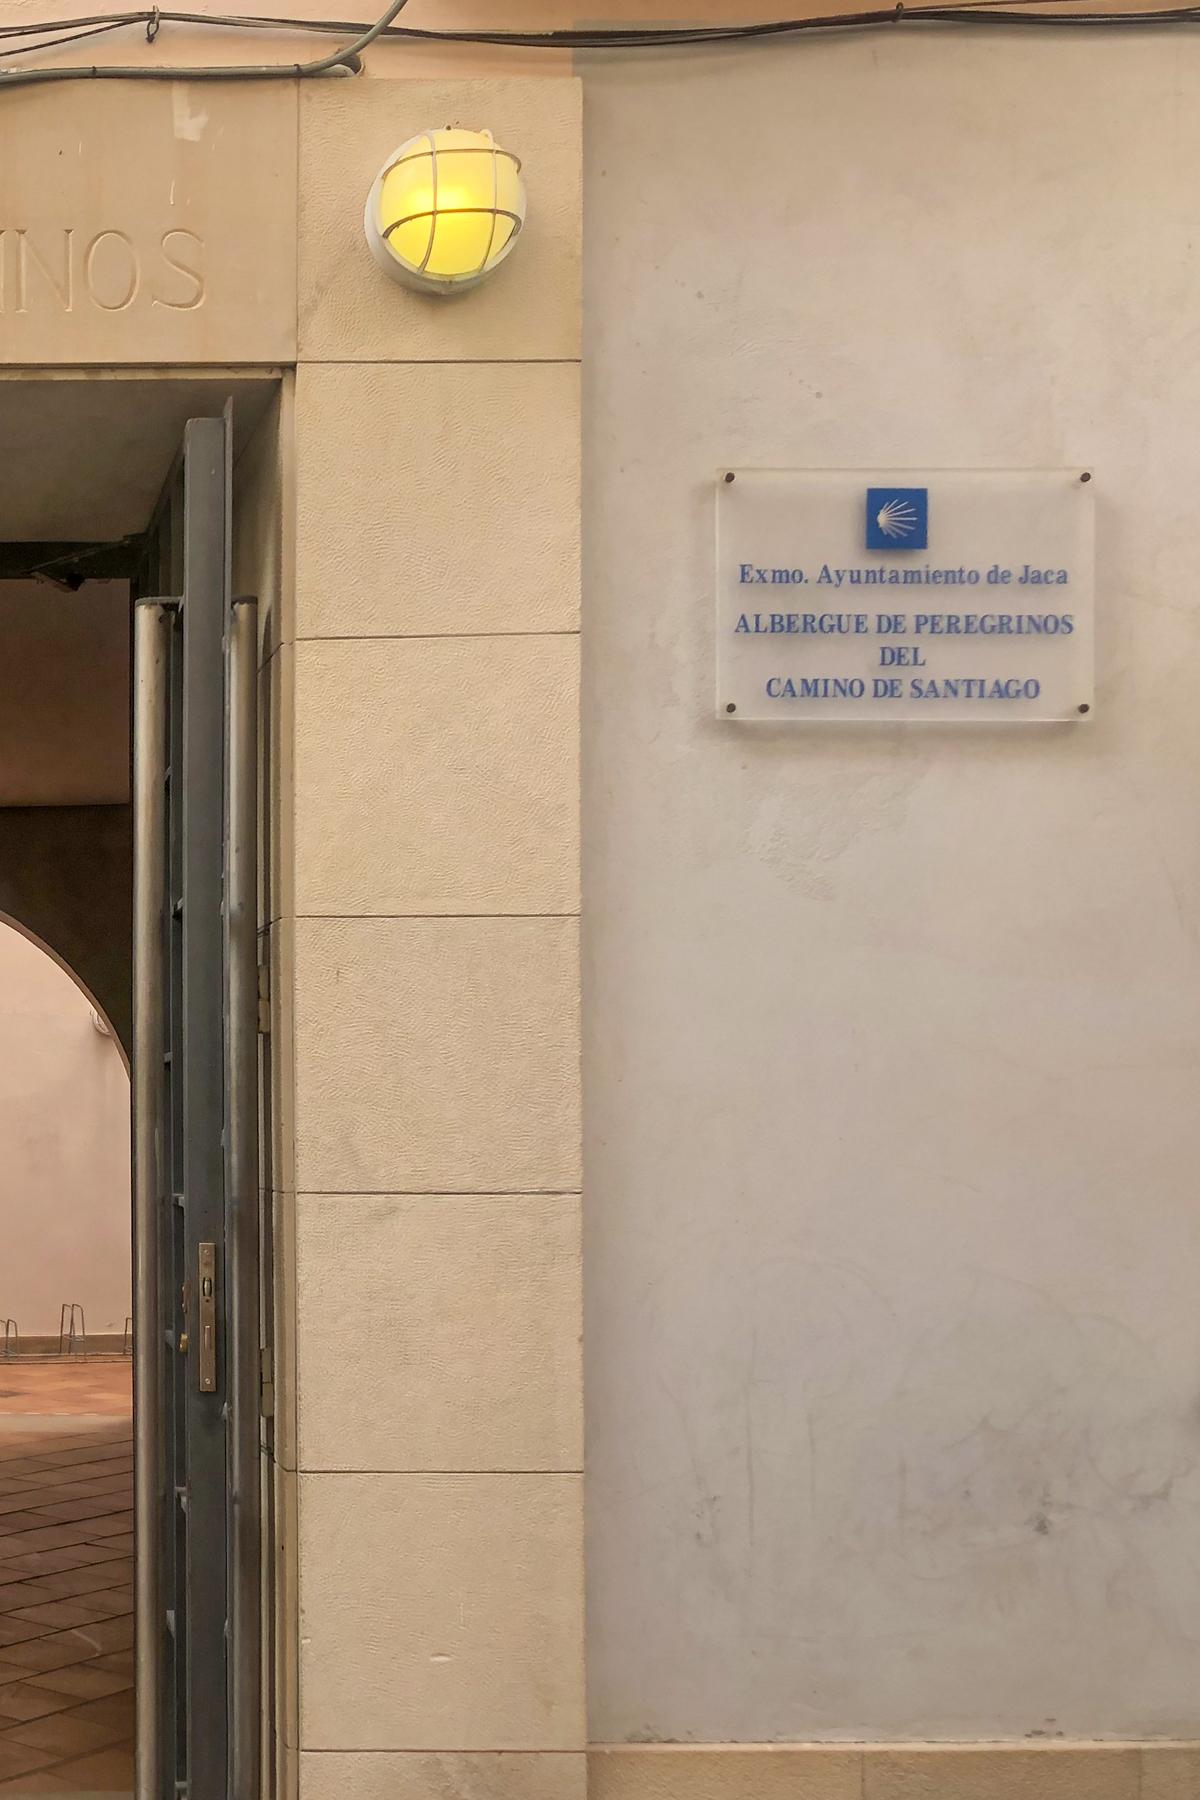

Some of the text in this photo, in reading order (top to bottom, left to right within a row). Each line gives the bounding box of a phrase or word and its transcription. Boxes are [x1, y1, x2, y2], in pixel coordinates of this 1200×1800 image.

[739, 564, 1068, 588] Exmo. Ayuntamiento de Jaca
[735, 613, 1074, 635] ALBERGUE DE PEREGRINOS
[880, 646, 926, 667] DEL
[766, 678, 1041, 700] CAMINO DE SANTIAGO
